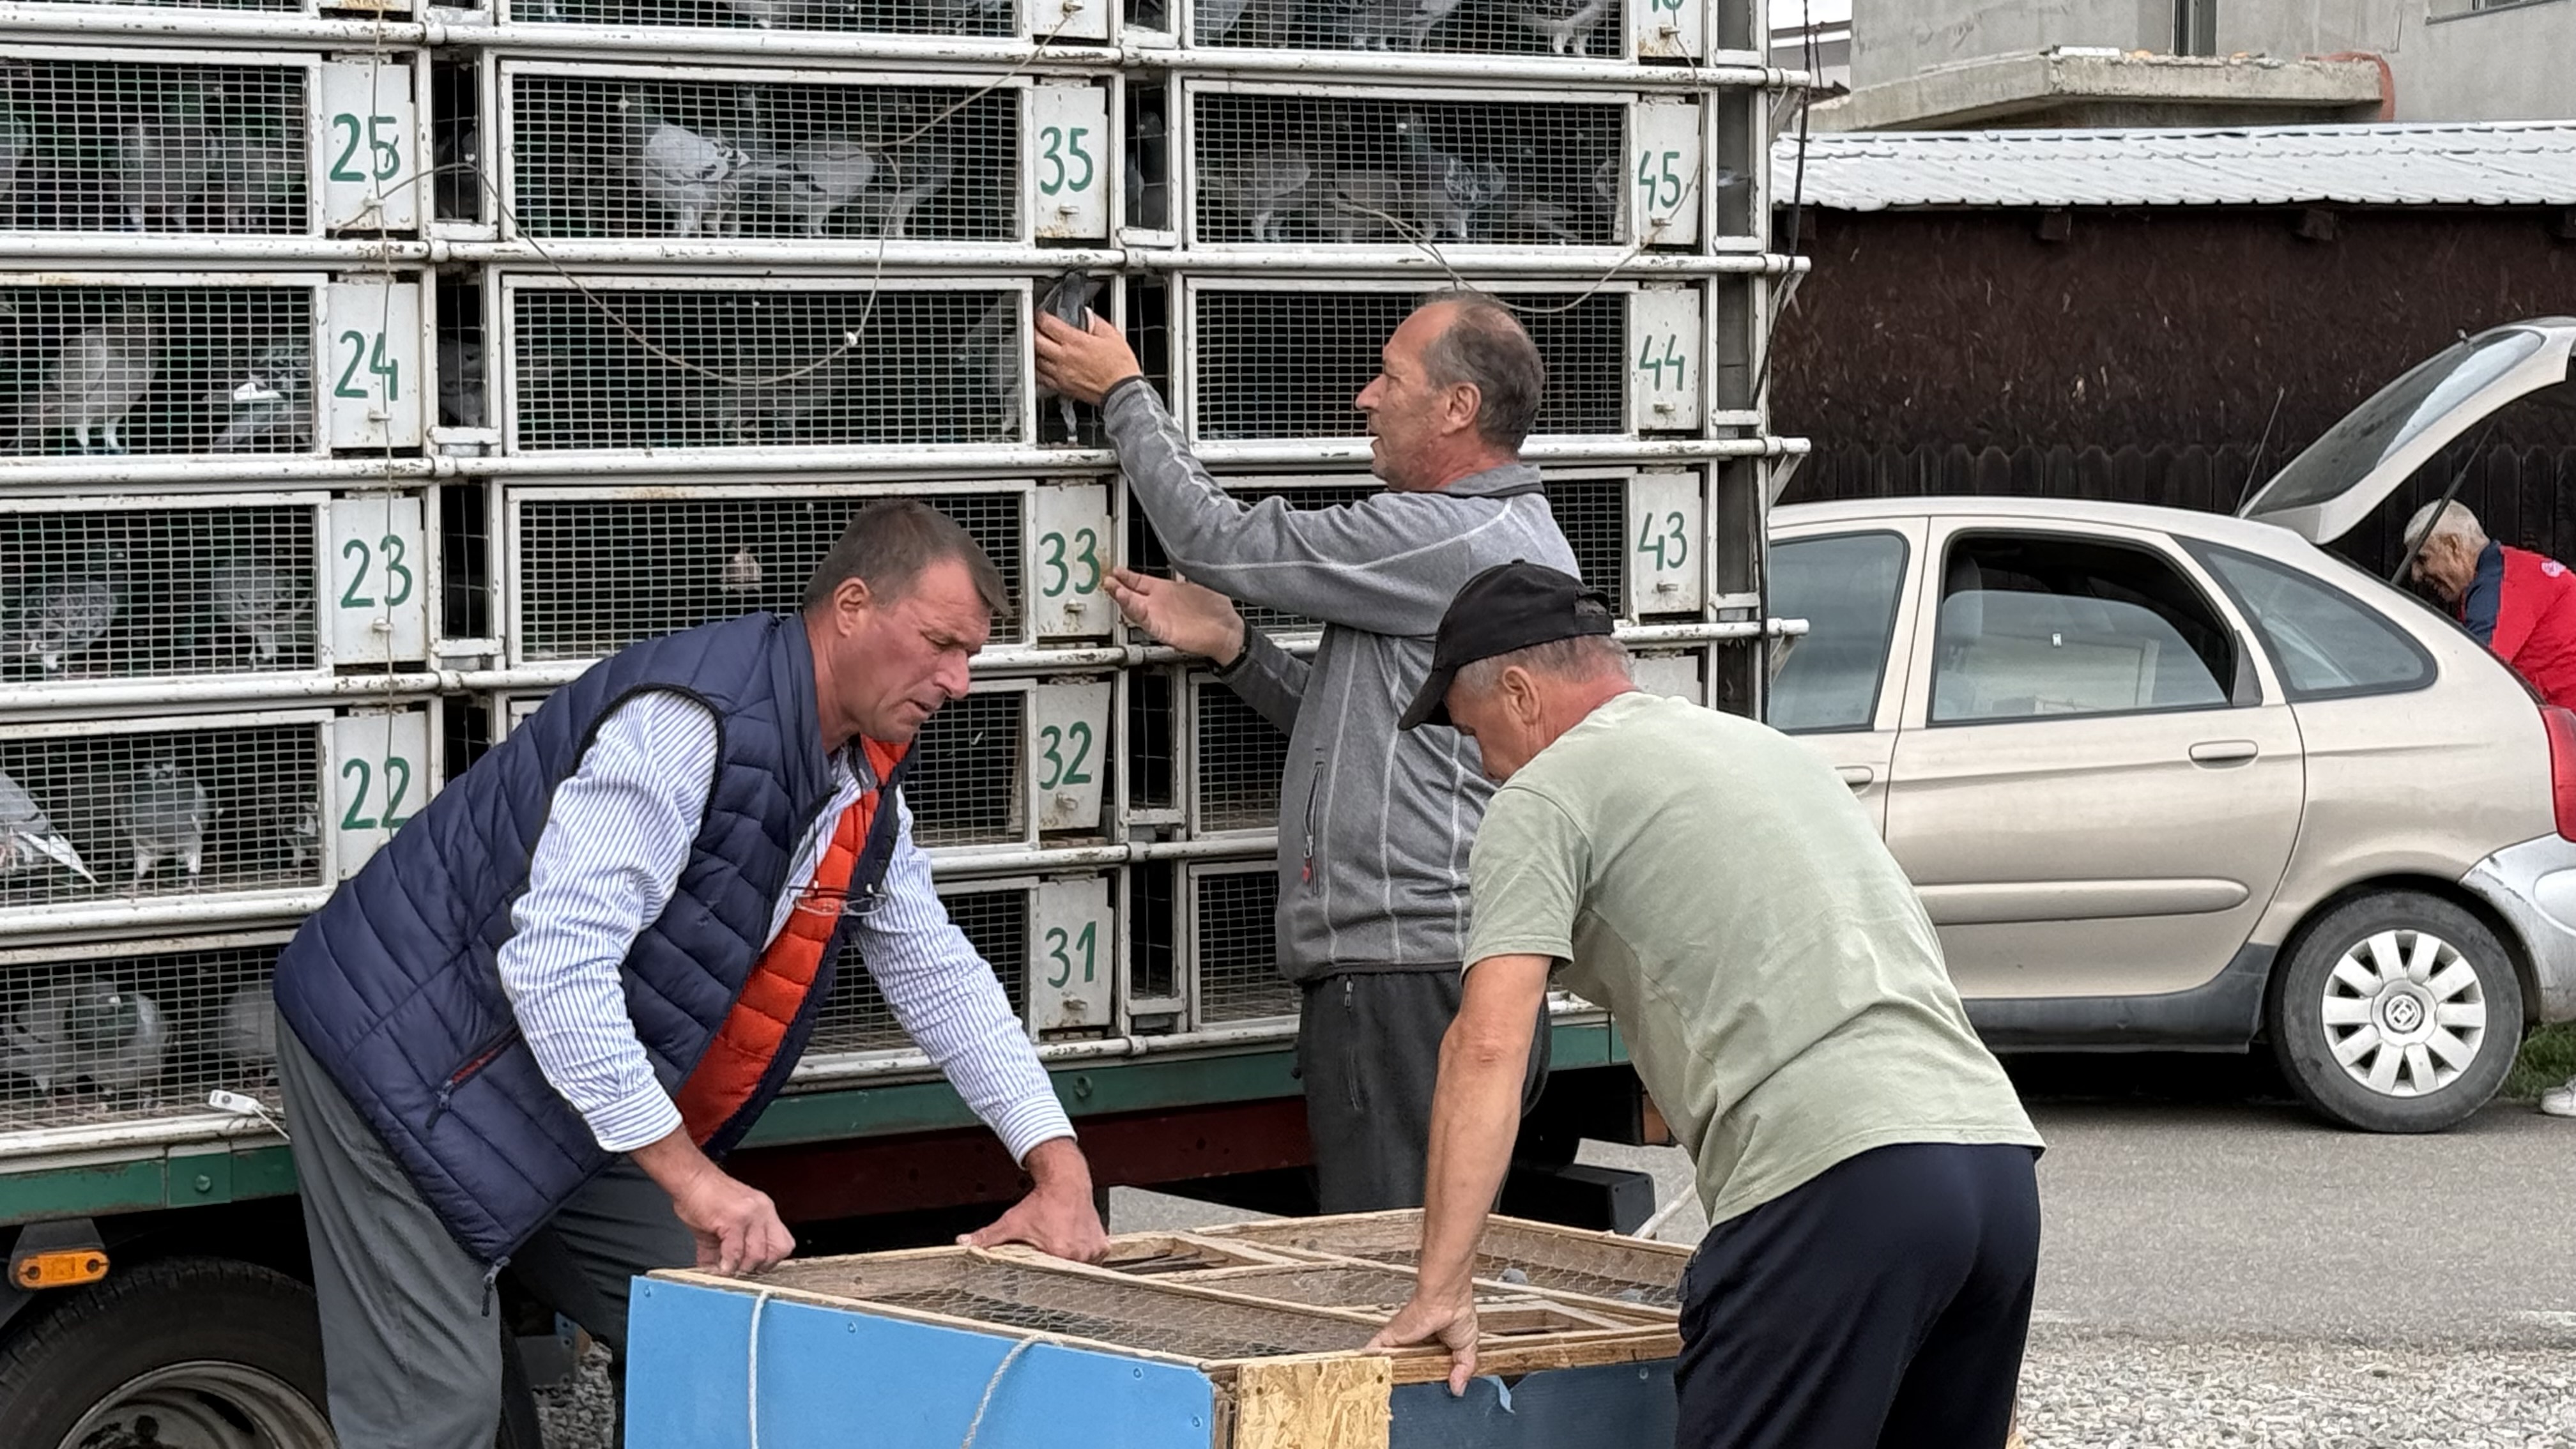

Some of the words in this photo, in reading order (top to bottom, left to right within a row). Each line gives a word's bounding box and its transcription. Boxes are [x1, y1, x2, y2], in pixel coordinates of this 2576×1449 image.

[330, 113, 400, 181] 25
[1039, 126, 1093, 195] 35
[1638, 151, 1682, 211] 45
[334, 330, 399, 401] 24
[1639, 334, 1685, 392] 44
[341, 535, 413, 608] 23
[1039, 528, 1101, 598] 33
[1637, 511, 1687, 571] 43
[1039, 721, 1093, 790] 32
[341, 756, 411, 830] 22
[1045, 920, 1097, 988] 31
